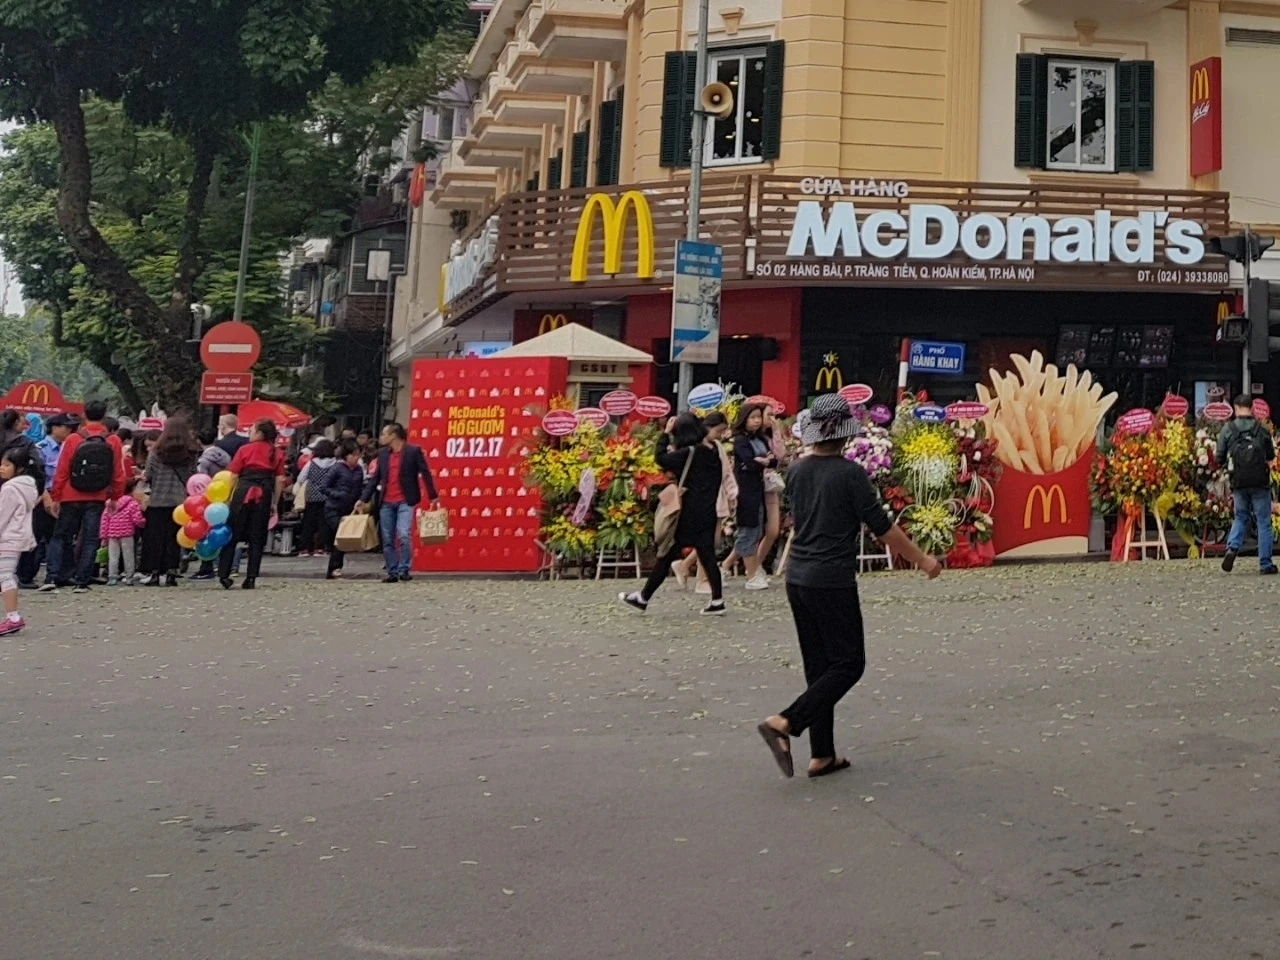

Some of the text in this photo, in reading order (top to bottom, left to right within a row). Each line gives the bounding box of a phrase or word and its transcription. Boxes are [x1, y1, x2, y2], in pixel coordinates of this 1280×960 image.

[800, 176, 909, 198] CỬA HÀNG
[786, 200, 1206, 266] McDonald's
[756, 260, 772, 277] SỐ
[773, 264, 787, 277] 02
[790, 261, 820, 278] HÀNG
[1018, 267, 1035, 282] NỘI
[1157, 270, 1182, 284] (024)
[1185, 271, 1229, 284] 39338080
[912, 354, 960, 369] HÀNG KHAY
[448, 405, 505, 419] McDonald's
[446, 437, 504, 458] 02.12.17
